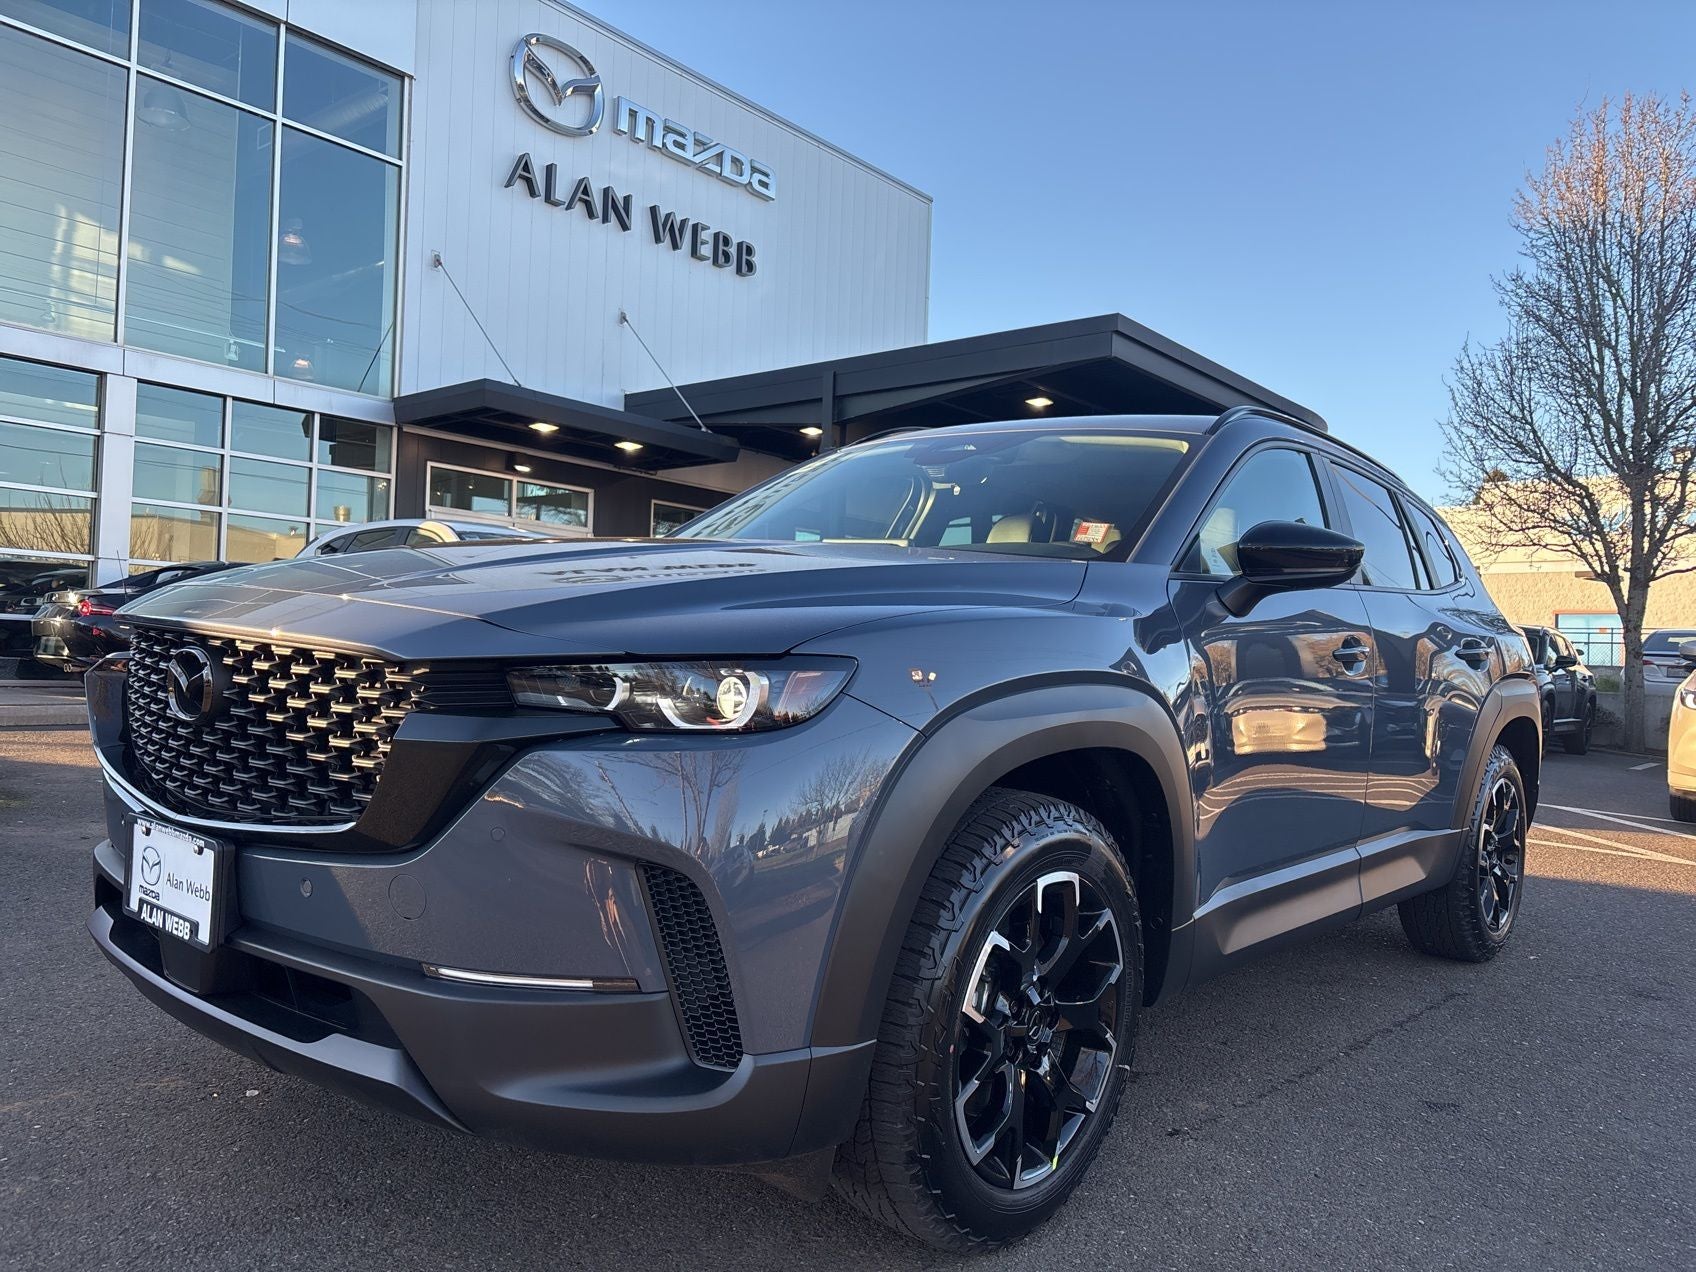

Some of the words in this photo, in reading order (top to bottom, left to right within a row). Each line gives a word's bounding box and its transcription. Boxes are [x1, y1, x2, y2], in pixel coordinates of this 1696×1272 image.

[613, 95, 776, 201] mazda
[504, 152, 633, 232] ALAN
[649, 204, 757, 277] WEBB
[139, 884, 160, 901] mazda
[166, 872, 184, 891] Alan
[186, 879, 211, 901] Webb
[140, 903, 163, 929] ALAN
[165, 912, 191, 940] WEBB
